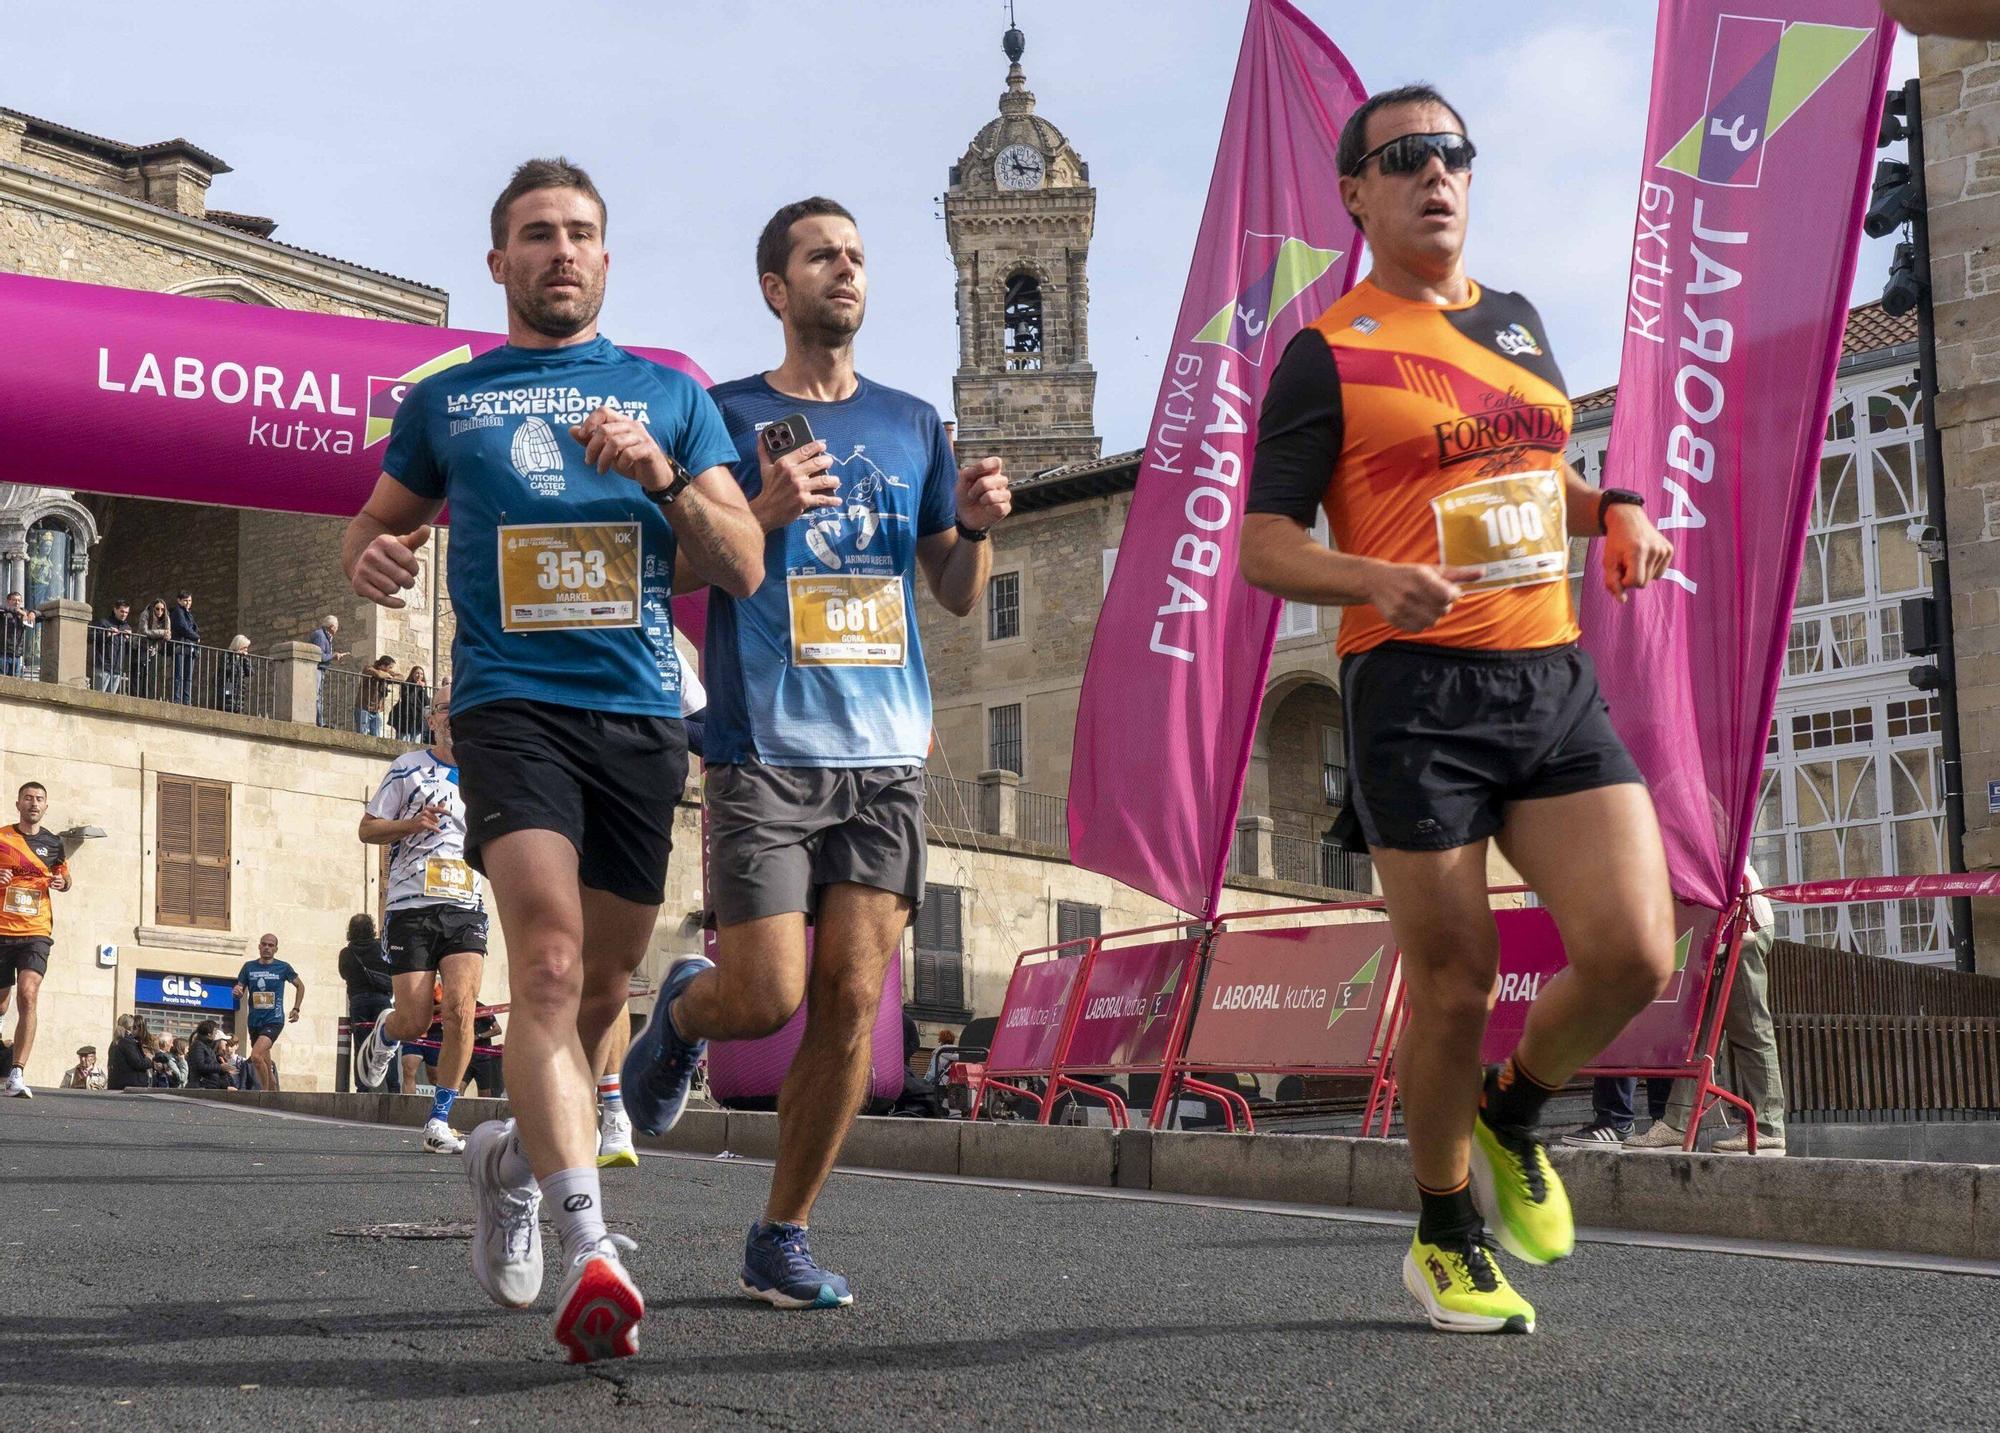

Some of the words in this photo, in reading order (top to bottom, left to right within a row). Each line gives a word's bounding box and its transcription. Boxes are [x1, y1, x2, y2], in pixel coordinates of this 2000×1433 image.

[98, 347, 356, 416] LABORAL
[447, 393, 468, 406] LA
[471, 387, 581, 404] CONQUISTA
[447, 404, 461, 414] DE
[463, 402, 478, 412] LA
[475, 395, 623, 417] ALMENDRA
[622, 400, 648, 411] REN
[248, 416, 354, 455] kutxa
[1432, 406, 1565, 459] FORONDA
[528, 474, 565, 483] VITORIA
[530, 482, 566, 491] GASTEIZ
[1480, 501, 1544, 548] 100
[615, 532, 632, 544] 10K
[536, 550, 607, 590] 353
[556, 592, 592, 602] MARKEL
[826, 597, 878, 632] 681
[1085, 995, 1125, 1020] LABORAL
[1121, 995, 1147, 1017] kutxa
[1212, 984, 1281, 1010] LABORAL
[1283, 985, 1327, 1009] kutxa
[1006, 1004, 1031, 1028] LABORAL
